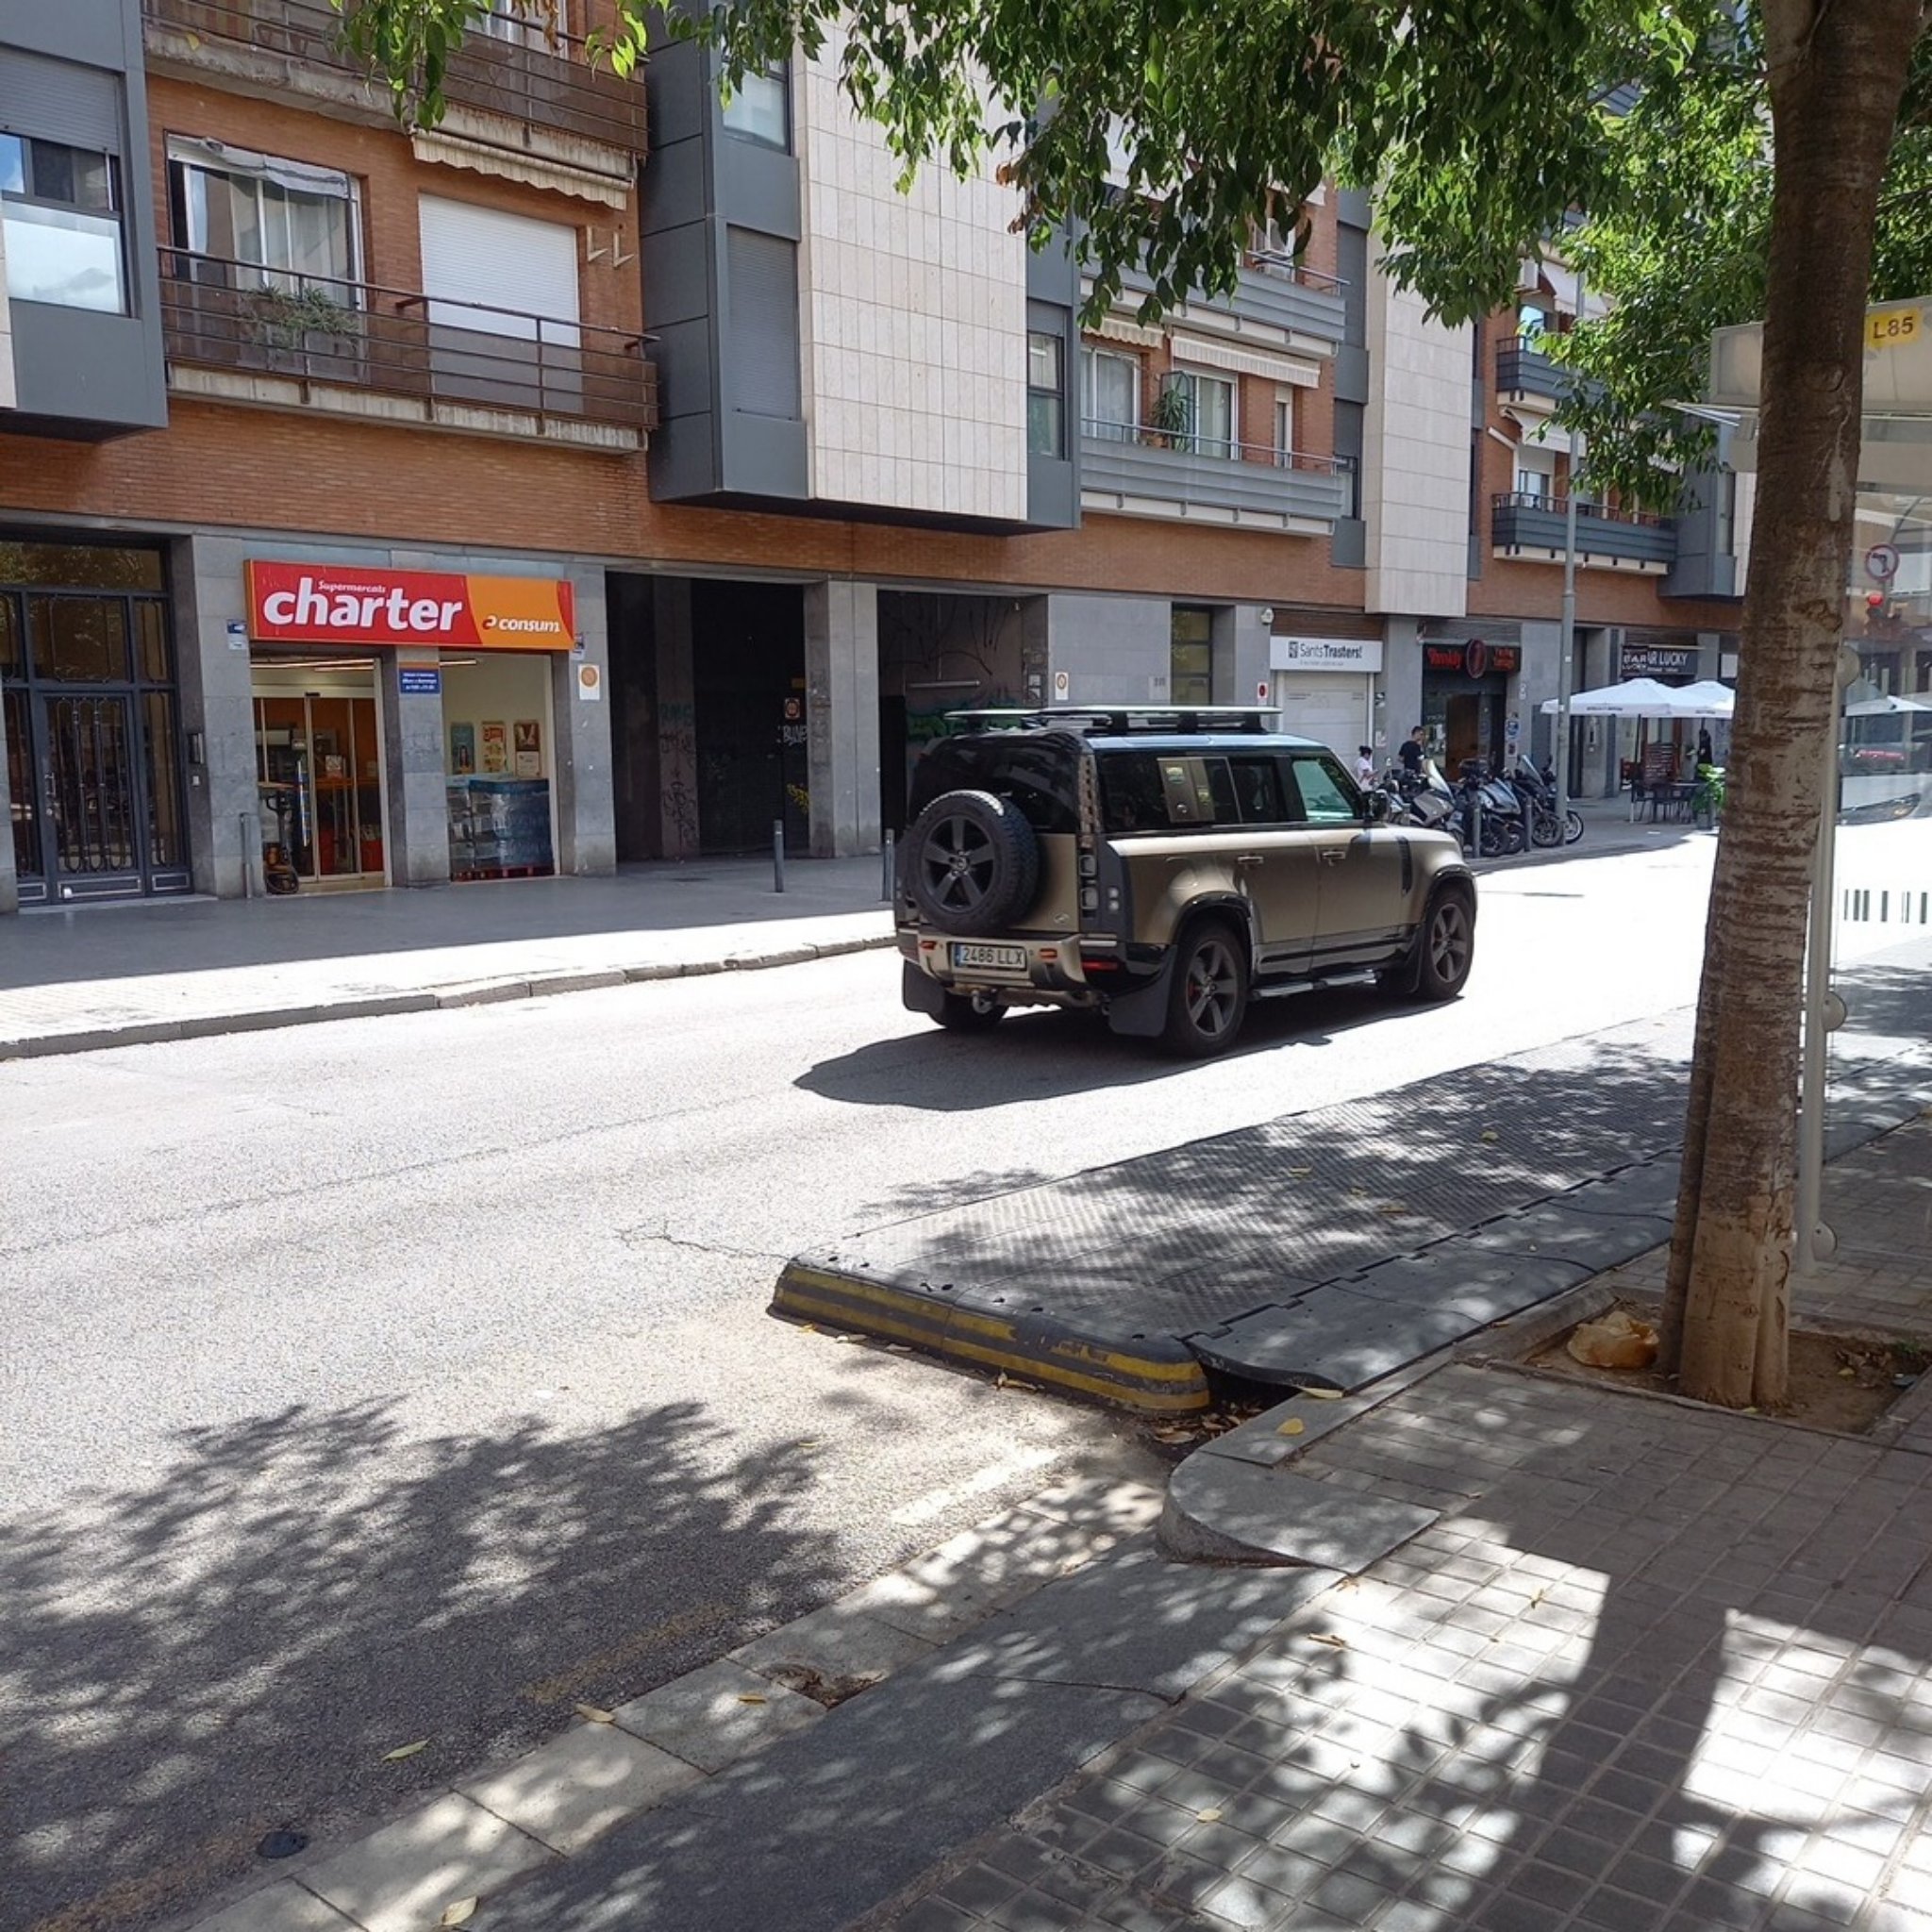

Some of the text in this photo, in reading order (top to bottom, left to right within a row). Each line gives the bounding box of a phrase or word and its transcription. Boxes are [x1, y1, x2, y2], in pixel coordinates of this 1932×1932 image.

[1873, 316, 1914, 340] L85
[263, 576, 462, 632] charter
[498, 618, 561, 633] consum
[1659, 650, 1689, 666] LUCKY
[962, 946, 1024, 965] 2486 LLX
